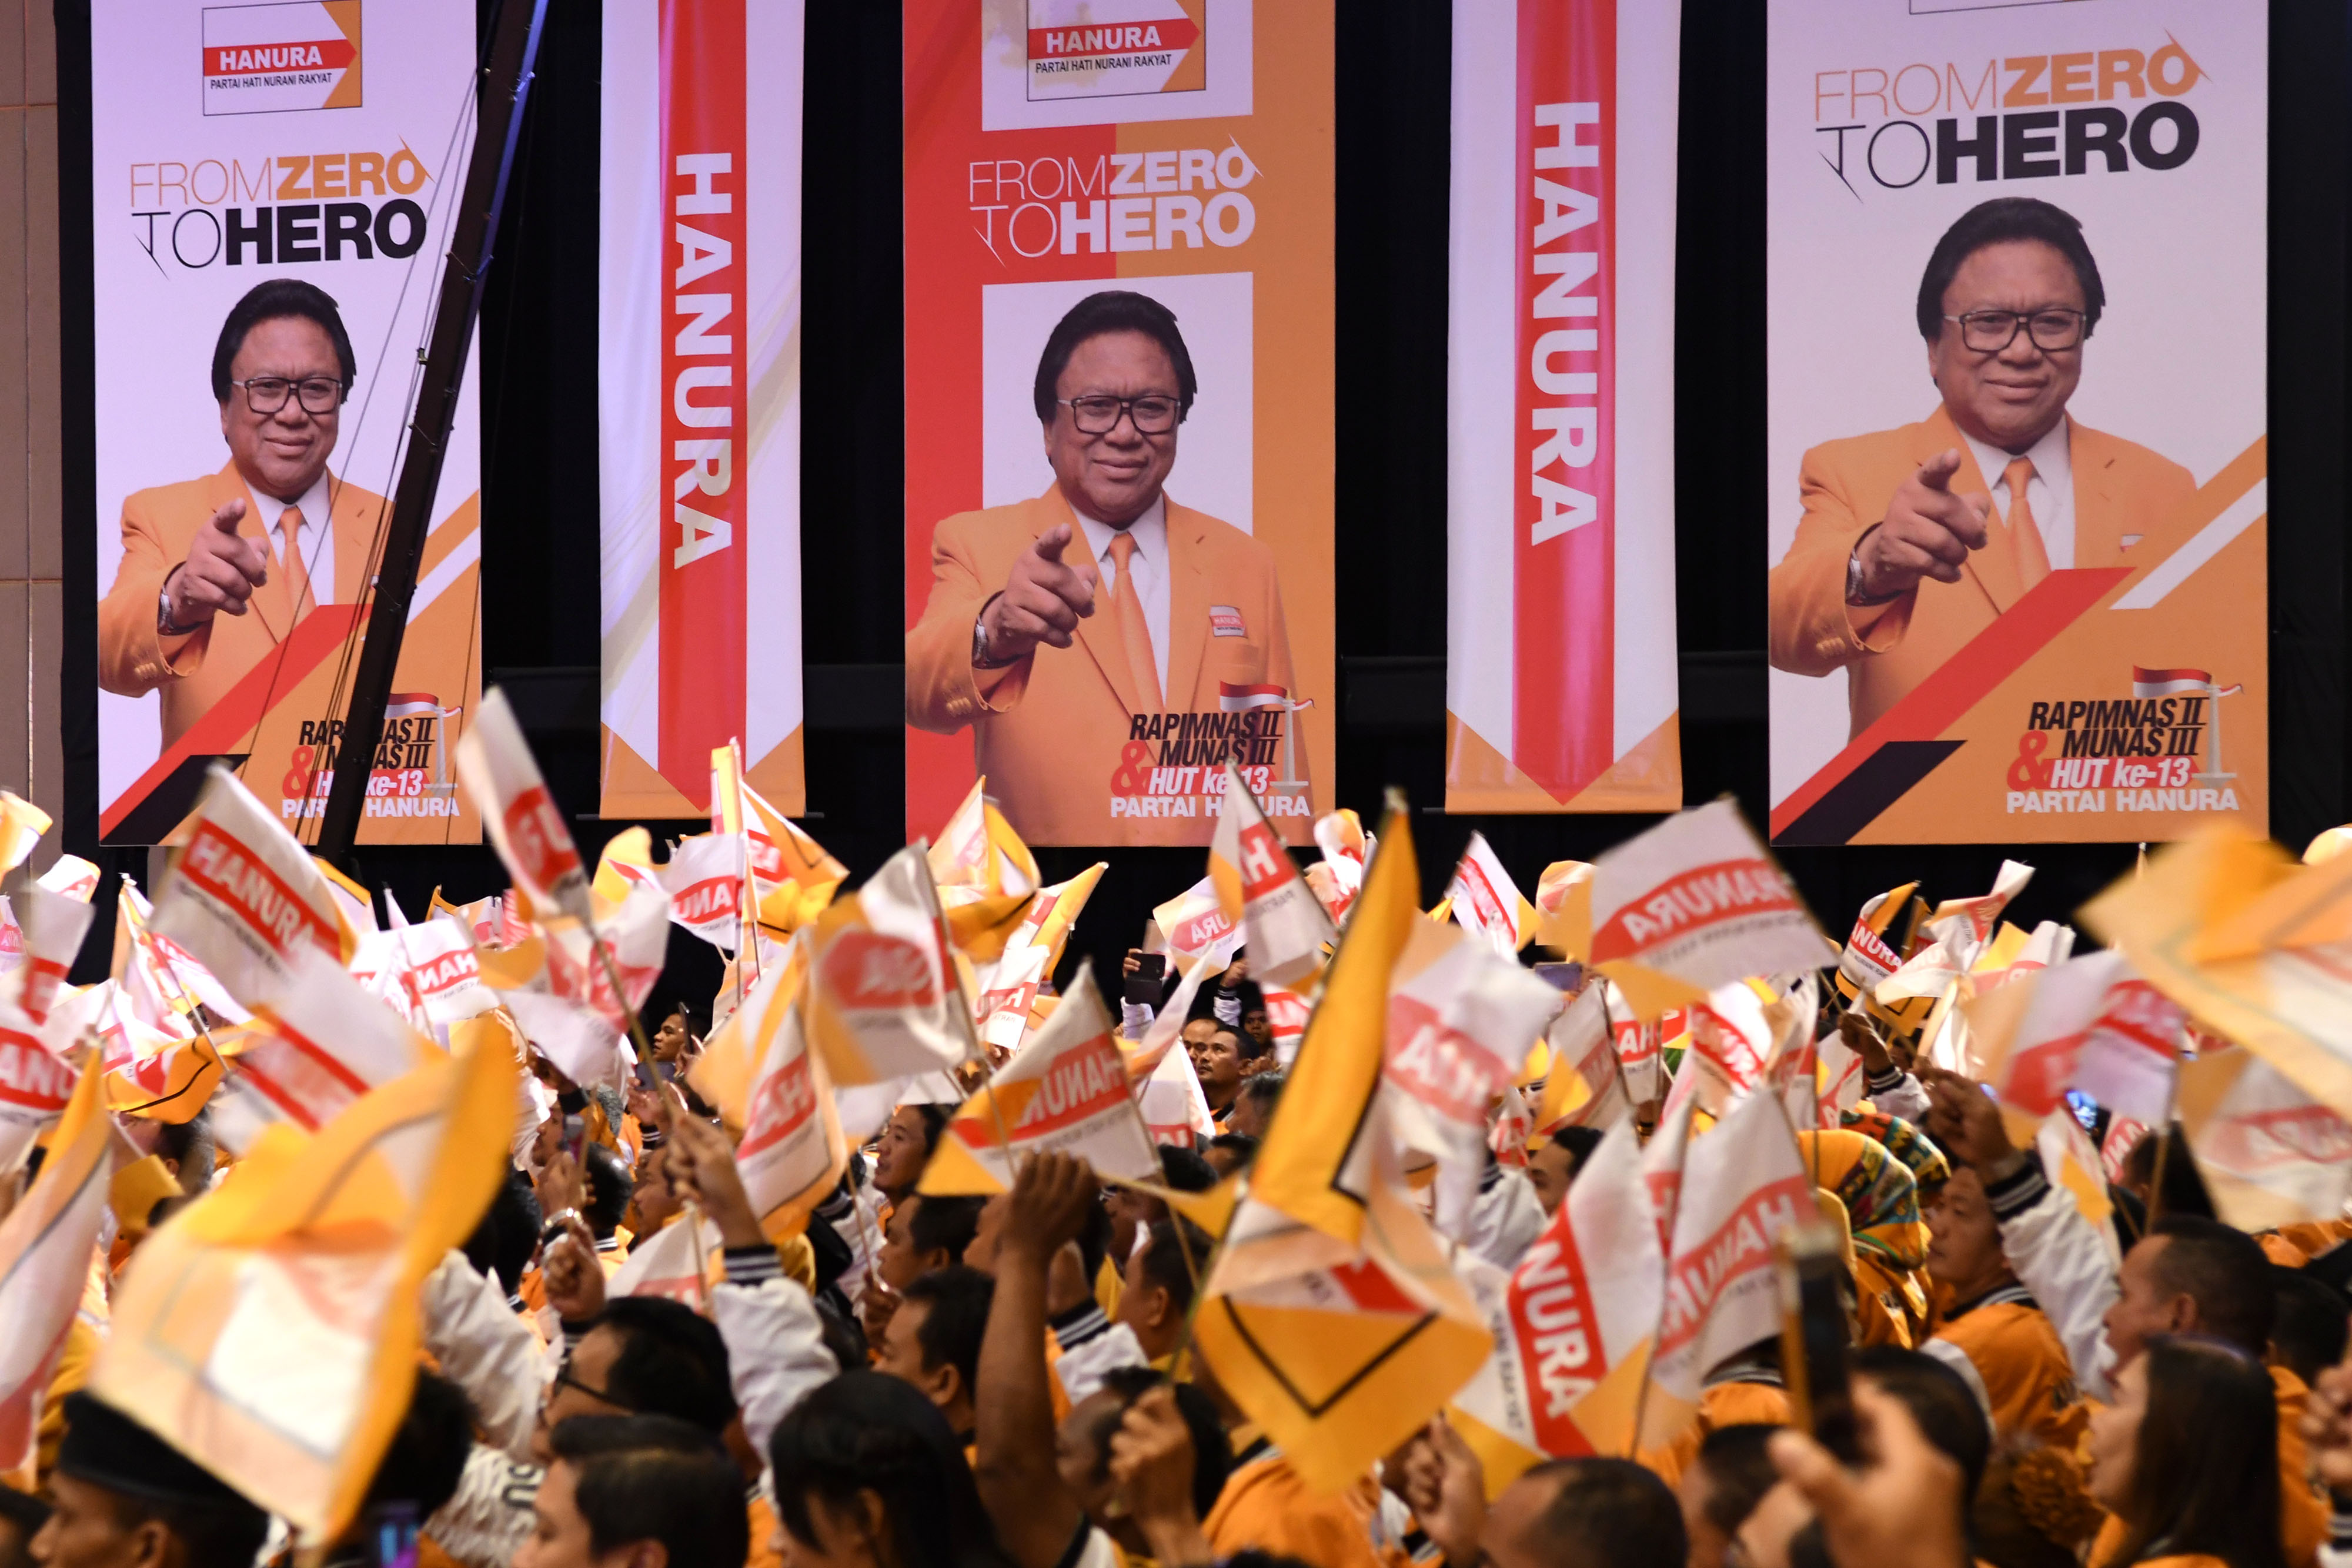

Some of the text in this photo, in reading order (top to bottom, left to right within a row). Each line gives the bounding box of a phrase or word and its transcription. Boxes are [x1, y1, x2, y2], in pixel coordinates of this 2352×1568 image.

[1047, 26, 1161, 54] HANURA
[220, 46, 323, 71] HANURA
[1035, 54, 1171, 74] PARTAI HATI NURANI RAKYAT
[1816, 27, 2213, 121] FROM ZERO
[211, 73, 332, 90] PARTAI HATI NURANI RAKYAT
[969, 133, 1264, 202] FROM ZERO
[1816, 101, 2199, 204] TO HERO
[131, 134, 435, 207] FROM ZERO
[132, 199, 426, 281] TO HERO
[970, 192, 1255, 267] TO HERO
[1531, 102, 1599, 546] HANURA
[674, 153, 732, 570] HANURA
[1130, 711, 1285, 740] RAPIMNAS II
[2028, 697, 2210, 730] RAPIMNAS II
[299, 717, 437, 745] RAPAS II
[2062, 727, 2202, 758] MUNAS III
[402, 743, 432, 769] III
[1159, 738, 1279, 766] MUNAS III
[2007, 730, 2048, 791] &
[282, 745, 313, 799] &
[1111, 740, 1147, 797] &
[1148, 765, 1268, 795] HUT ke13
[2050, 757, 2191, 788] HUT ke-13
[366, 797, 460, 817] HANURA
[1111, 796, 1310, 818] PARTAI HURA
[2006, 788, 2239, 813] PARTAI HANURA
